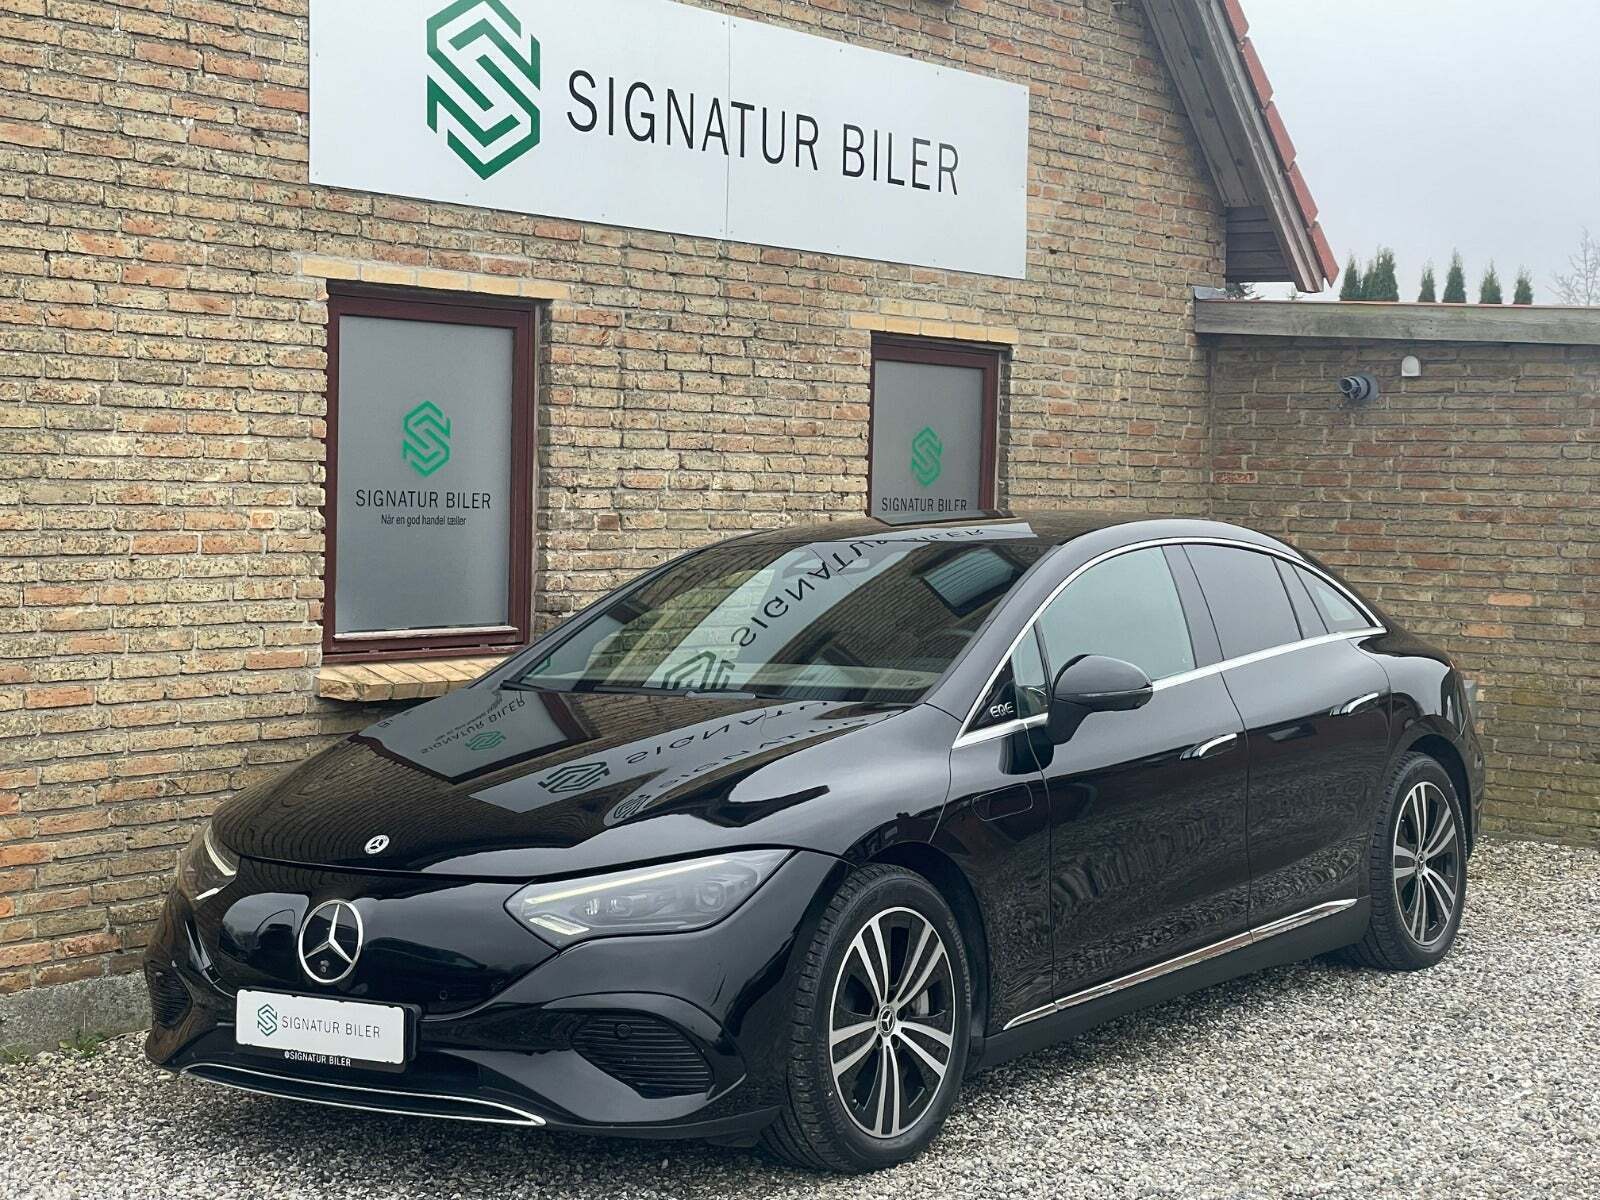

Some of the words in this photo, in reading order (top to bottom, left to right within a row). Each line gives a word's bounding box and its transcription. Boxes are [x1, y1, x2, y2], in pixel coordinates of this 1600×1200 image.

[567, 69, 819, 171] SIGNATUR
[842, 123, 960, 196] BILER
[355, 489, 439, 508] SIGNATUR
[446, 492, 491, 509] BILER
[881, 497, 934, 512] SIGNATUR
[937, 498, 967, 512] BILER
[381, 514, 395, 525] Når
[396, 516, 405, 525] en
[407, 515, 420, 527] god
[422, 515, 446, 525] handel
[990, 702, 1014, 718] EQE
[281, 1015, 340, 1035] SIGNATUR
[345, 1022, 381, 1039] BILER
[328, 1055, 351, 1067] BILER
